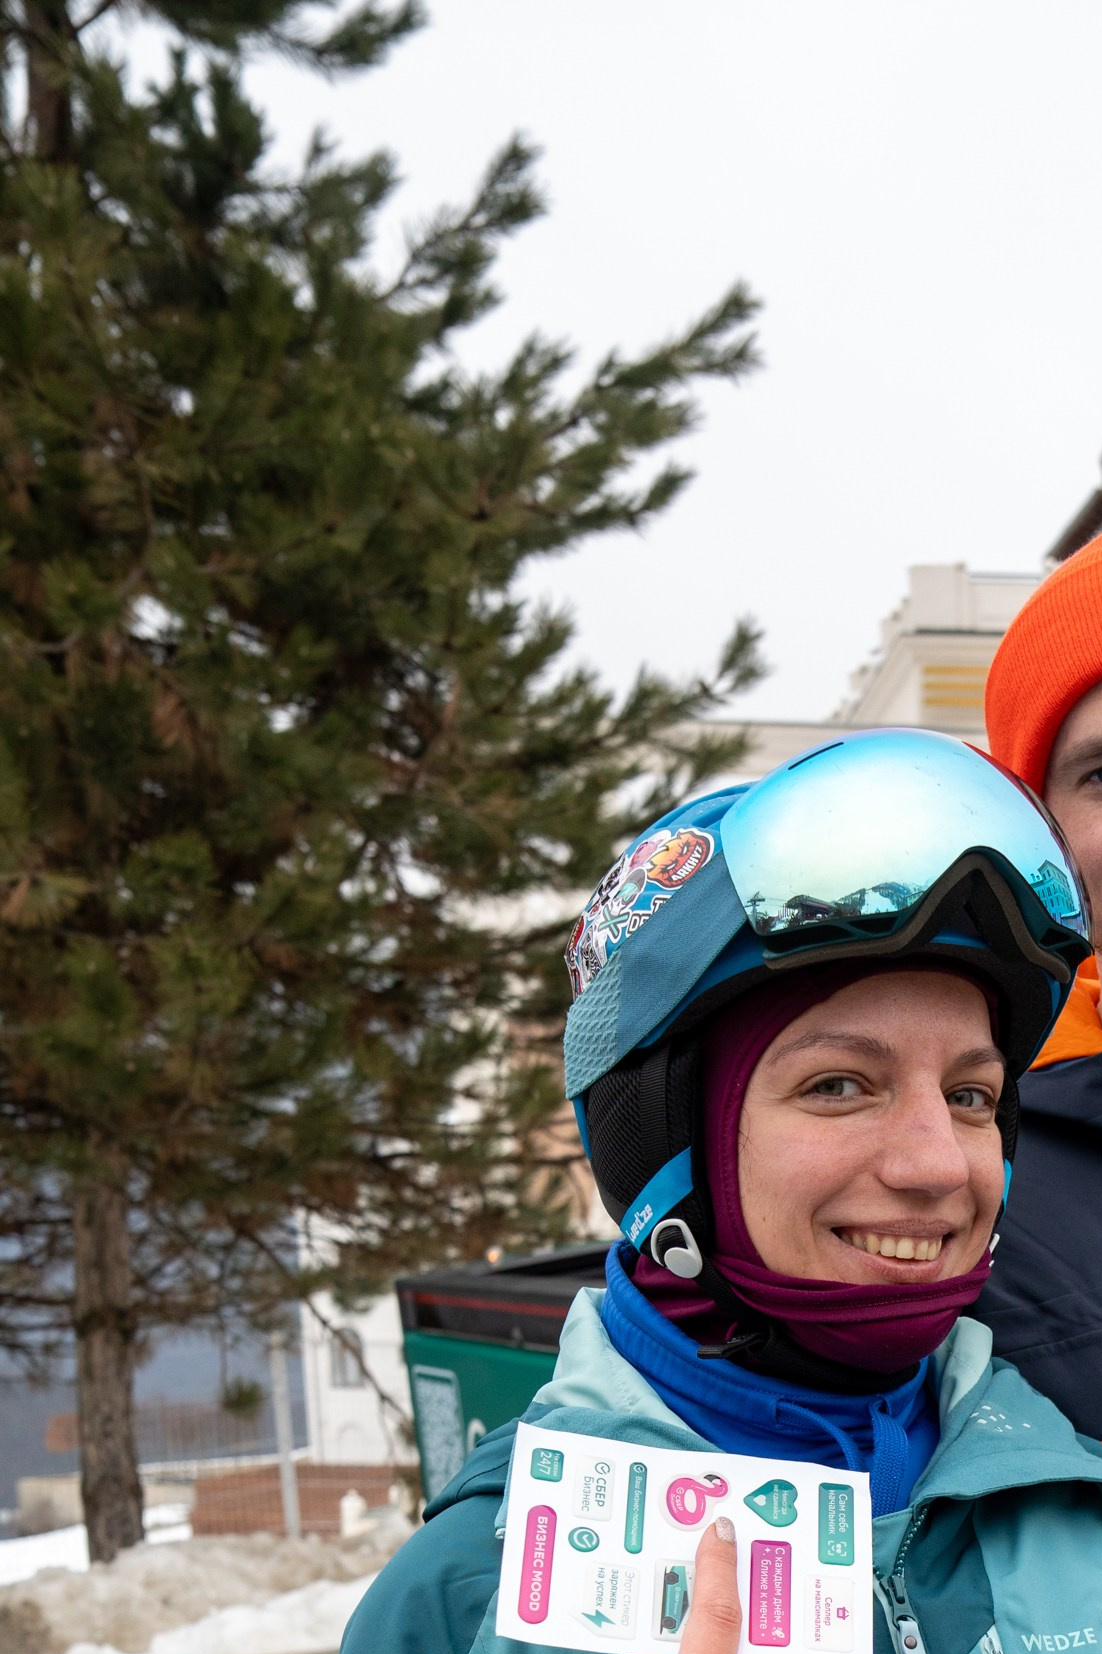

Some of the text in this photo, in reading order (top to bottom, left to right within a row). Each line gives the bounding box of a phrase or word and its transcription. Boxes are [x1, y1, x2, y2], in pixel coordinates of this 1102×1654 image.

[671, 846, 702, 882] ARKHYZ
[537, 1451, 553, 1476] 24/7
[581, 1476, 594, 1512] Бизнес
[594, 1477, 607, 1507] СБЕР
[828, 1490, 836, 1535] начальник
[838, 1494, 848, 1533] Сам себе
[532, 1516, 548, 1568] БИЗНЕС
[594, 1567, 605, 1607] на успех
[609, 1569, 619, 1609] заряжен
[760, 1559, 771, 1590] ближе
[773, 1557, 783, 1596] каждым
[815, 1579, 821, 1588] на
[759, 1600, 768, 1630] мечте
[773, 1597, 785, 1623] днём
[823, 1597, 832, 1626] Селлер
[1021, 1628, 1098, 1652] WEDZE
